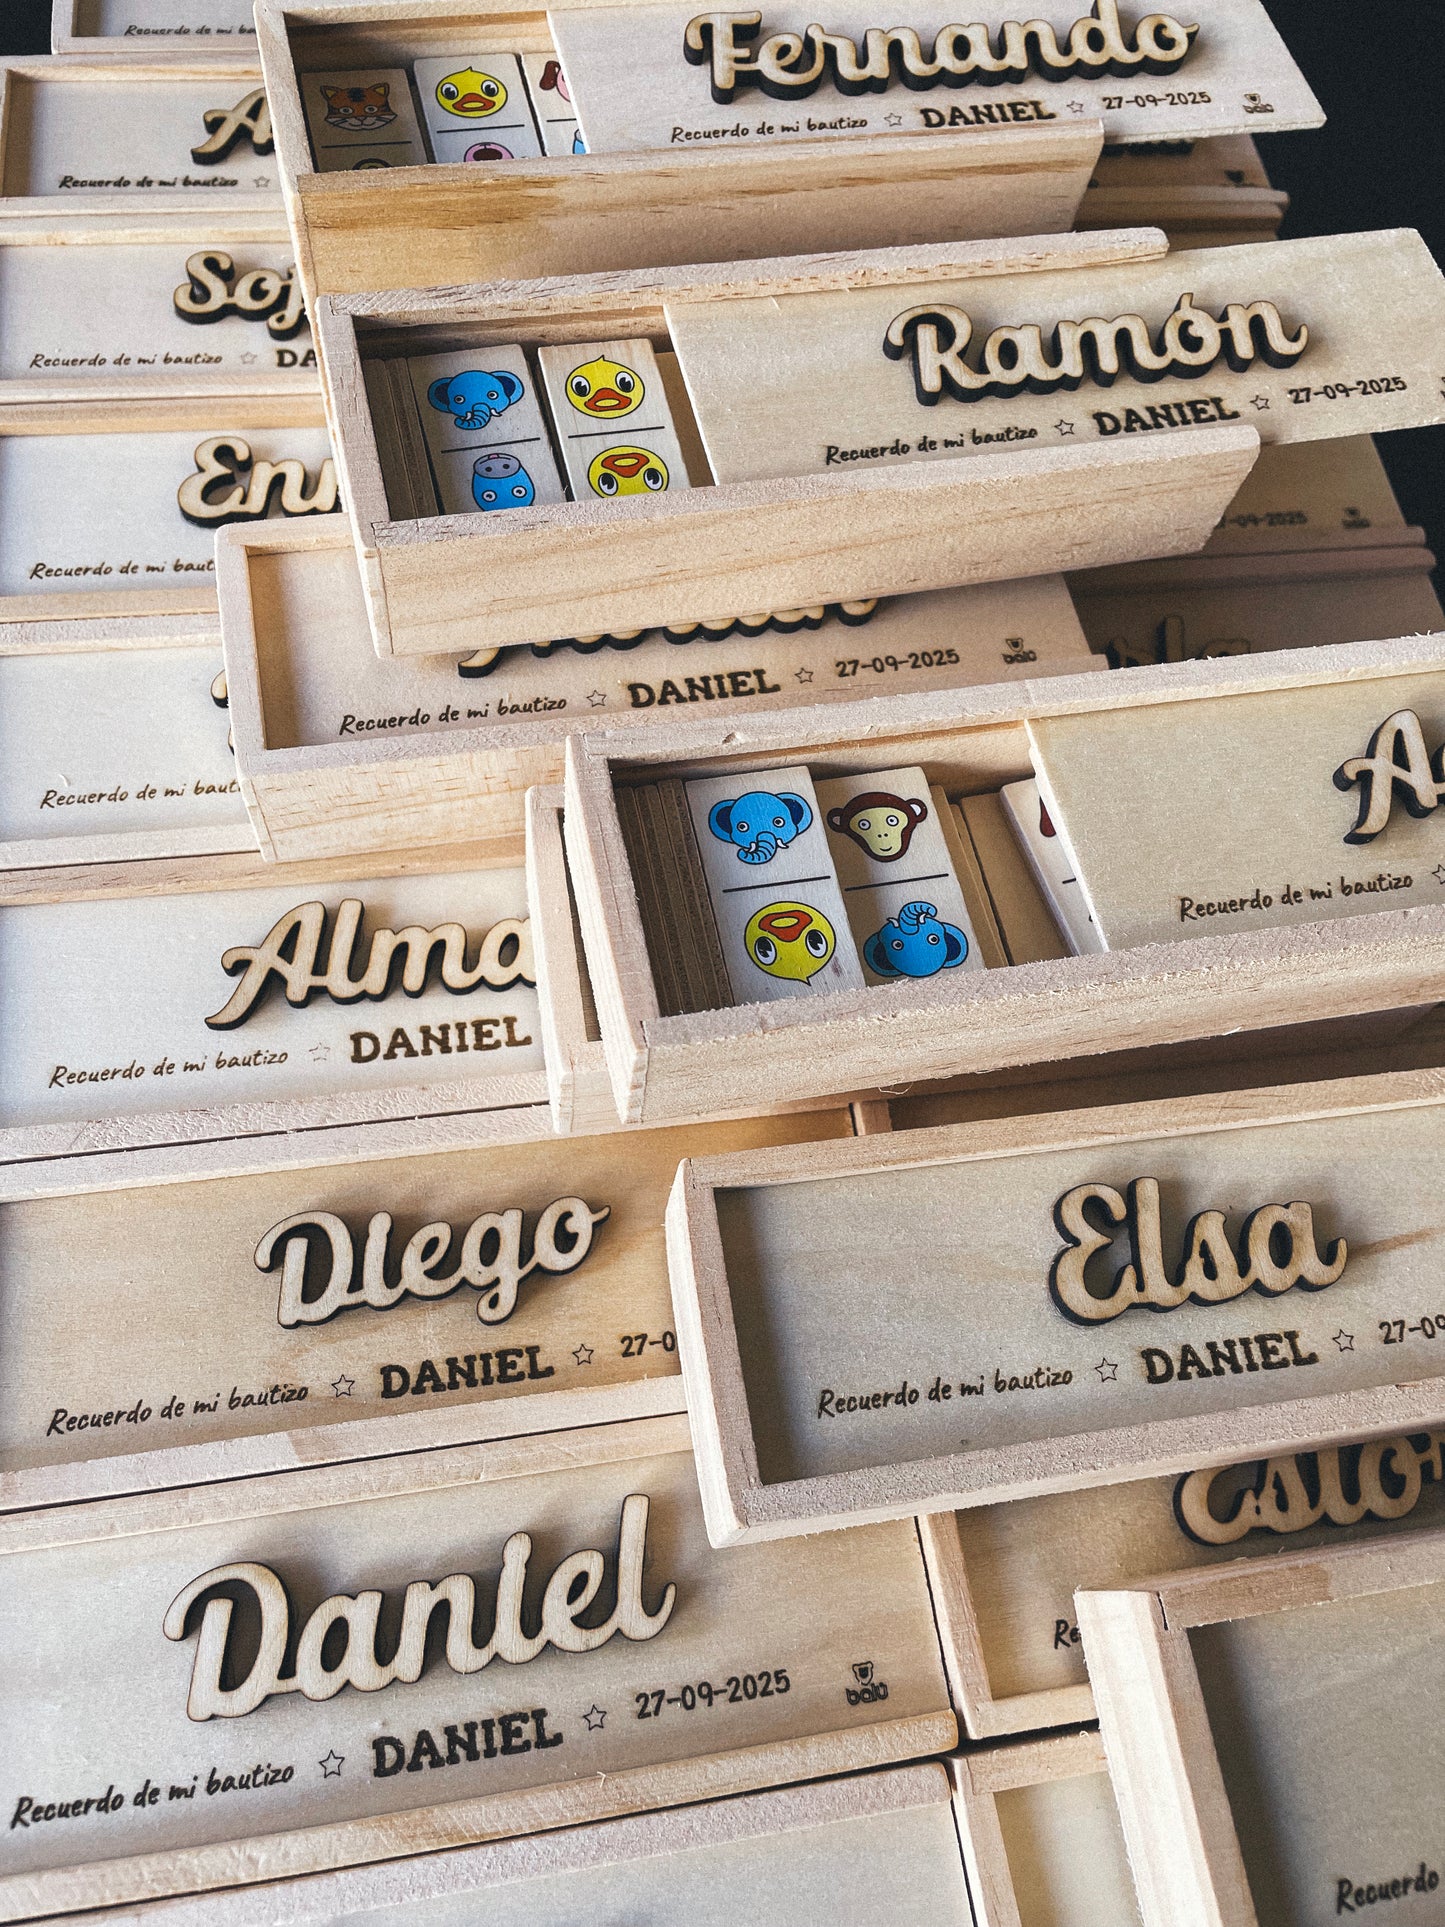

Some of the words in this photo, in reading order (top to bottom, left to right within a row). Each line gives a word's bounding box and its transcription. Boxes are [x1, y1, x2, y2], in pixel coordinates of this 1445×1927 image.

[683, 0, 1200, 105] Fernando
[671, 125, 749, 143] Recuerdo
[756, 122, 774, 136] de
[781, 122, 799, 133] mi
[807, 117, 868, 131] bautizo
[920, 100, 1056, 128] DANIEL
[1103, 91, 1212, 110] 27-09-2025
[59, 176, 130, 188] Recuerdo
[136, 176, 153, 187] de
[158, 177, 176, 187] mi
[182, 176, 238, 187] bautizo
[29, 354, 106, 368] Recuerdo
[113, 353, 131, 366] de
[137, 353, 155, 365] mi
[163, 352, 222, 365] bautizo
[883, 293, 1308, 406] Ramón
[826, 439, 910, 465] Recuerdo
[918, 436, 937, 451] de
[944, 433, 964, 448] mi
[972, 427, 1038, 444] bautizo
[1092, 396, 1240, 436] DANIEL
[1288, 376, 1407, 404] 27-09-2025
[29, 561, 113, 580] Recuerdo
[119, 560, 138, 575] de
[146, 561, 165, 573] mi
[173, 559, 215, 572] baut
[339, 709, 431, 735] Recuerdo
[439, 703, 460, 722] de
[467, 703, 490, 718] mi
[497, 696, 567, 715] bautizo
[627, 669, 781, 709] DANIEL
[836, 649, 960, 678] 27-09-2025
[40, 786, 128, 809] Recuerdo
[136, 783, 157, 800] de
[164, 783, 187, 797] mi
[1332, 709, 1445, 845] A
[1180, 888, 1273, 922] Recuerdo
[1281, 884, 1303, 906] de
[1310, 882, 1332, 900] mi
[1340, 873, 1413, 896] bautizo
[204, 898, 536, 1030] Alma
[48, 1057, 146, 1089] Recuerdo
[153, 1054, 175, 1076] de
[183, 1053, 208, 1072] mi
[215, 1048, 289, 1070] bautizo
[349, 1016, 532, 1064] DANIEL
[254, 1196, 611, 1329] Diego
[1050, 1176, 1347, 1326] Elsa
[46, 1400, 152, 1436] Recuerdo
[160, 1396, 184, 1420] de
[193, 1393, 218, 1413] mi
[228, 1385, 309, 1410] bautizo
[380, 1346, 555, 1399] DANIEL
[817, 1381, 919, 1419] Recuerdo
[928, 1377, 952, 1402] de
[960, 1375, 985, 1396] mi
[994, 1367, 1073, 1392] bautizo
[1141, 1330, 1319, 1384] DANIEL
[163, 1493, 677, 1722] Daniel
[10, 1784, 124, 1830] Recuerdo
[133, 1779, 161, 1808] de
[168, 1775, 196, 1801] mi
[206, 1764, 295, 1795] bautizo
[371, 1708, 564, 1778] DANIEL
[635, 1669, 791, 1719] 27-09-2025
[1336, 1861, 1440, 1916] Recuerdo
